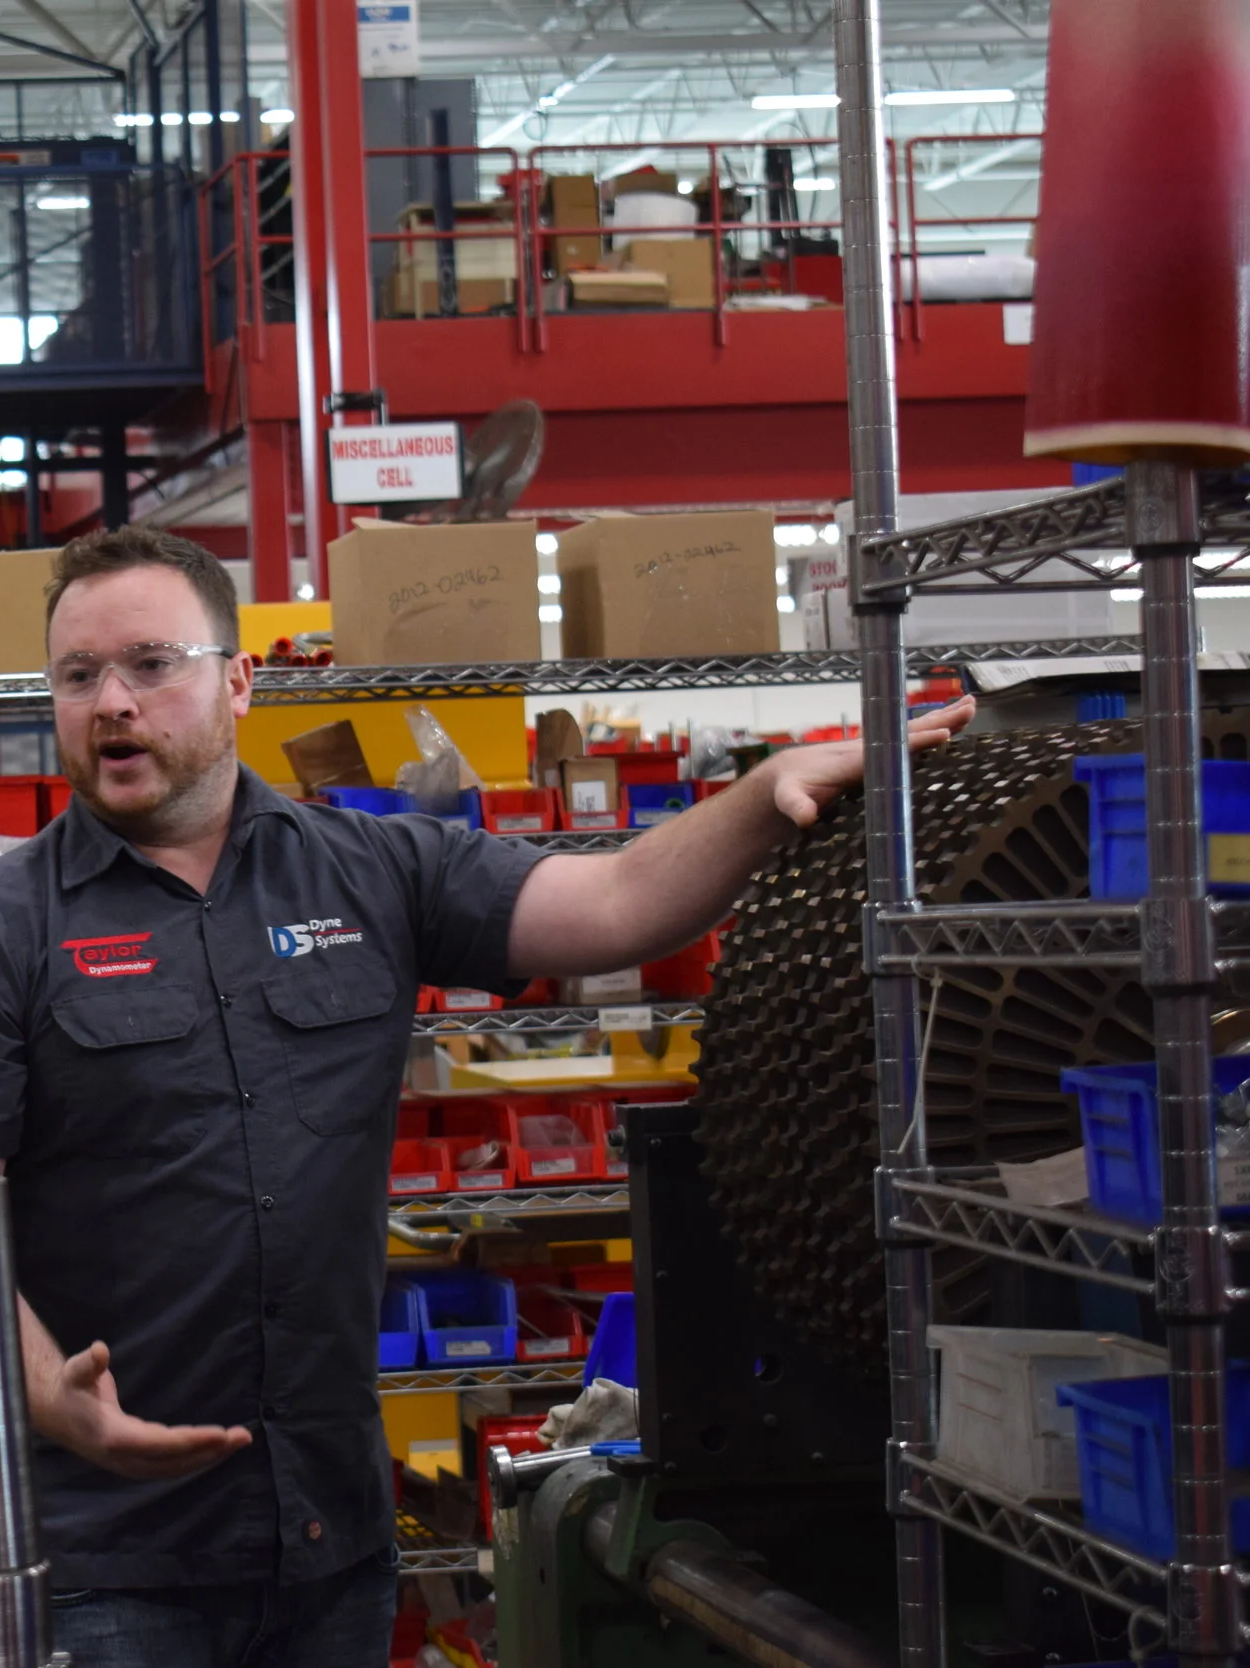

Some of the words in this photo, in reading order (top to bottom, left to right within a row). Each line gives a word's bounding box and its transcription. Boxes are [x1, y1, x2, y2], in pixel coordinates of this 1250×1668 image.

[333, 436, 454, 460] MISCELLANEOUS
[377, 467, 414, 488] CELL
[309, 918, 342, 932] Dyne
[267, 924, 314, 957] DS
[315, 933, 363, 949] Systems
[60, 932, 155, 974] Taylor
[89, 962, 152, 975] Dynamometer
